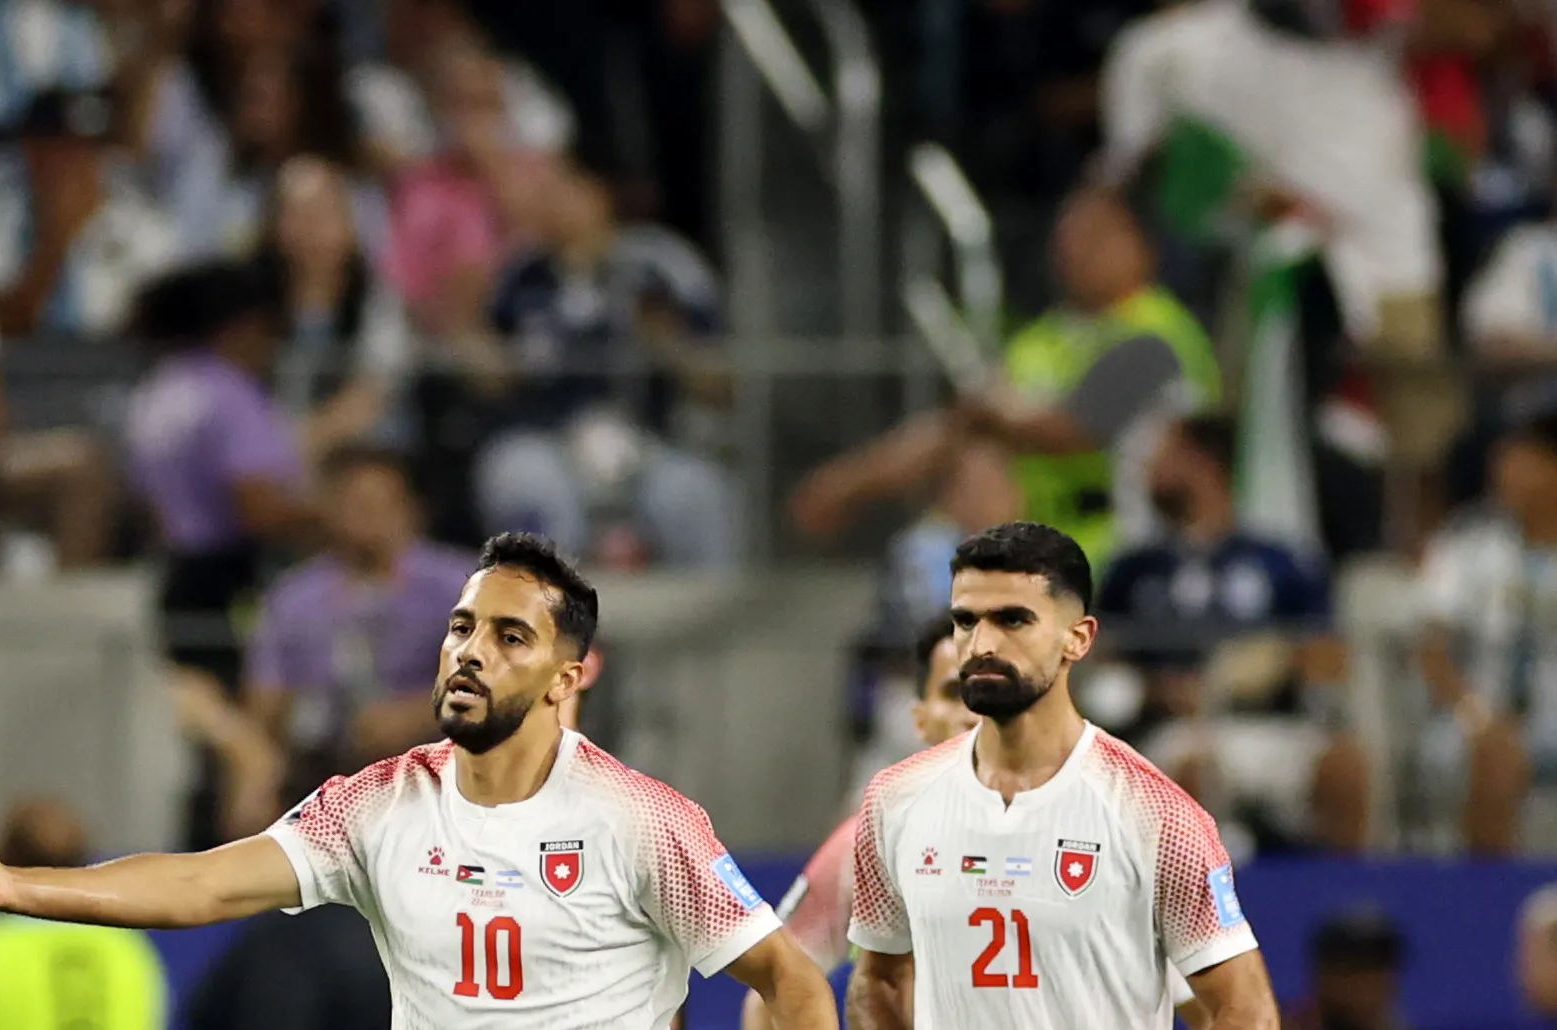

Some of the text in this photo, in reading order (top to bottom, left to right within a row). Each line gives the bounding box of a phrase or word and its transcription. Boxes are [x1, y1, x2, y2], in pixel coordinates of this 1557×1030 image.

[545, 841, 580, 851] JORDAN
[418, 866, 450, 877] KELME
[453, 912, 523, 1000] 10
[968, 907, 1038, 988] 21
